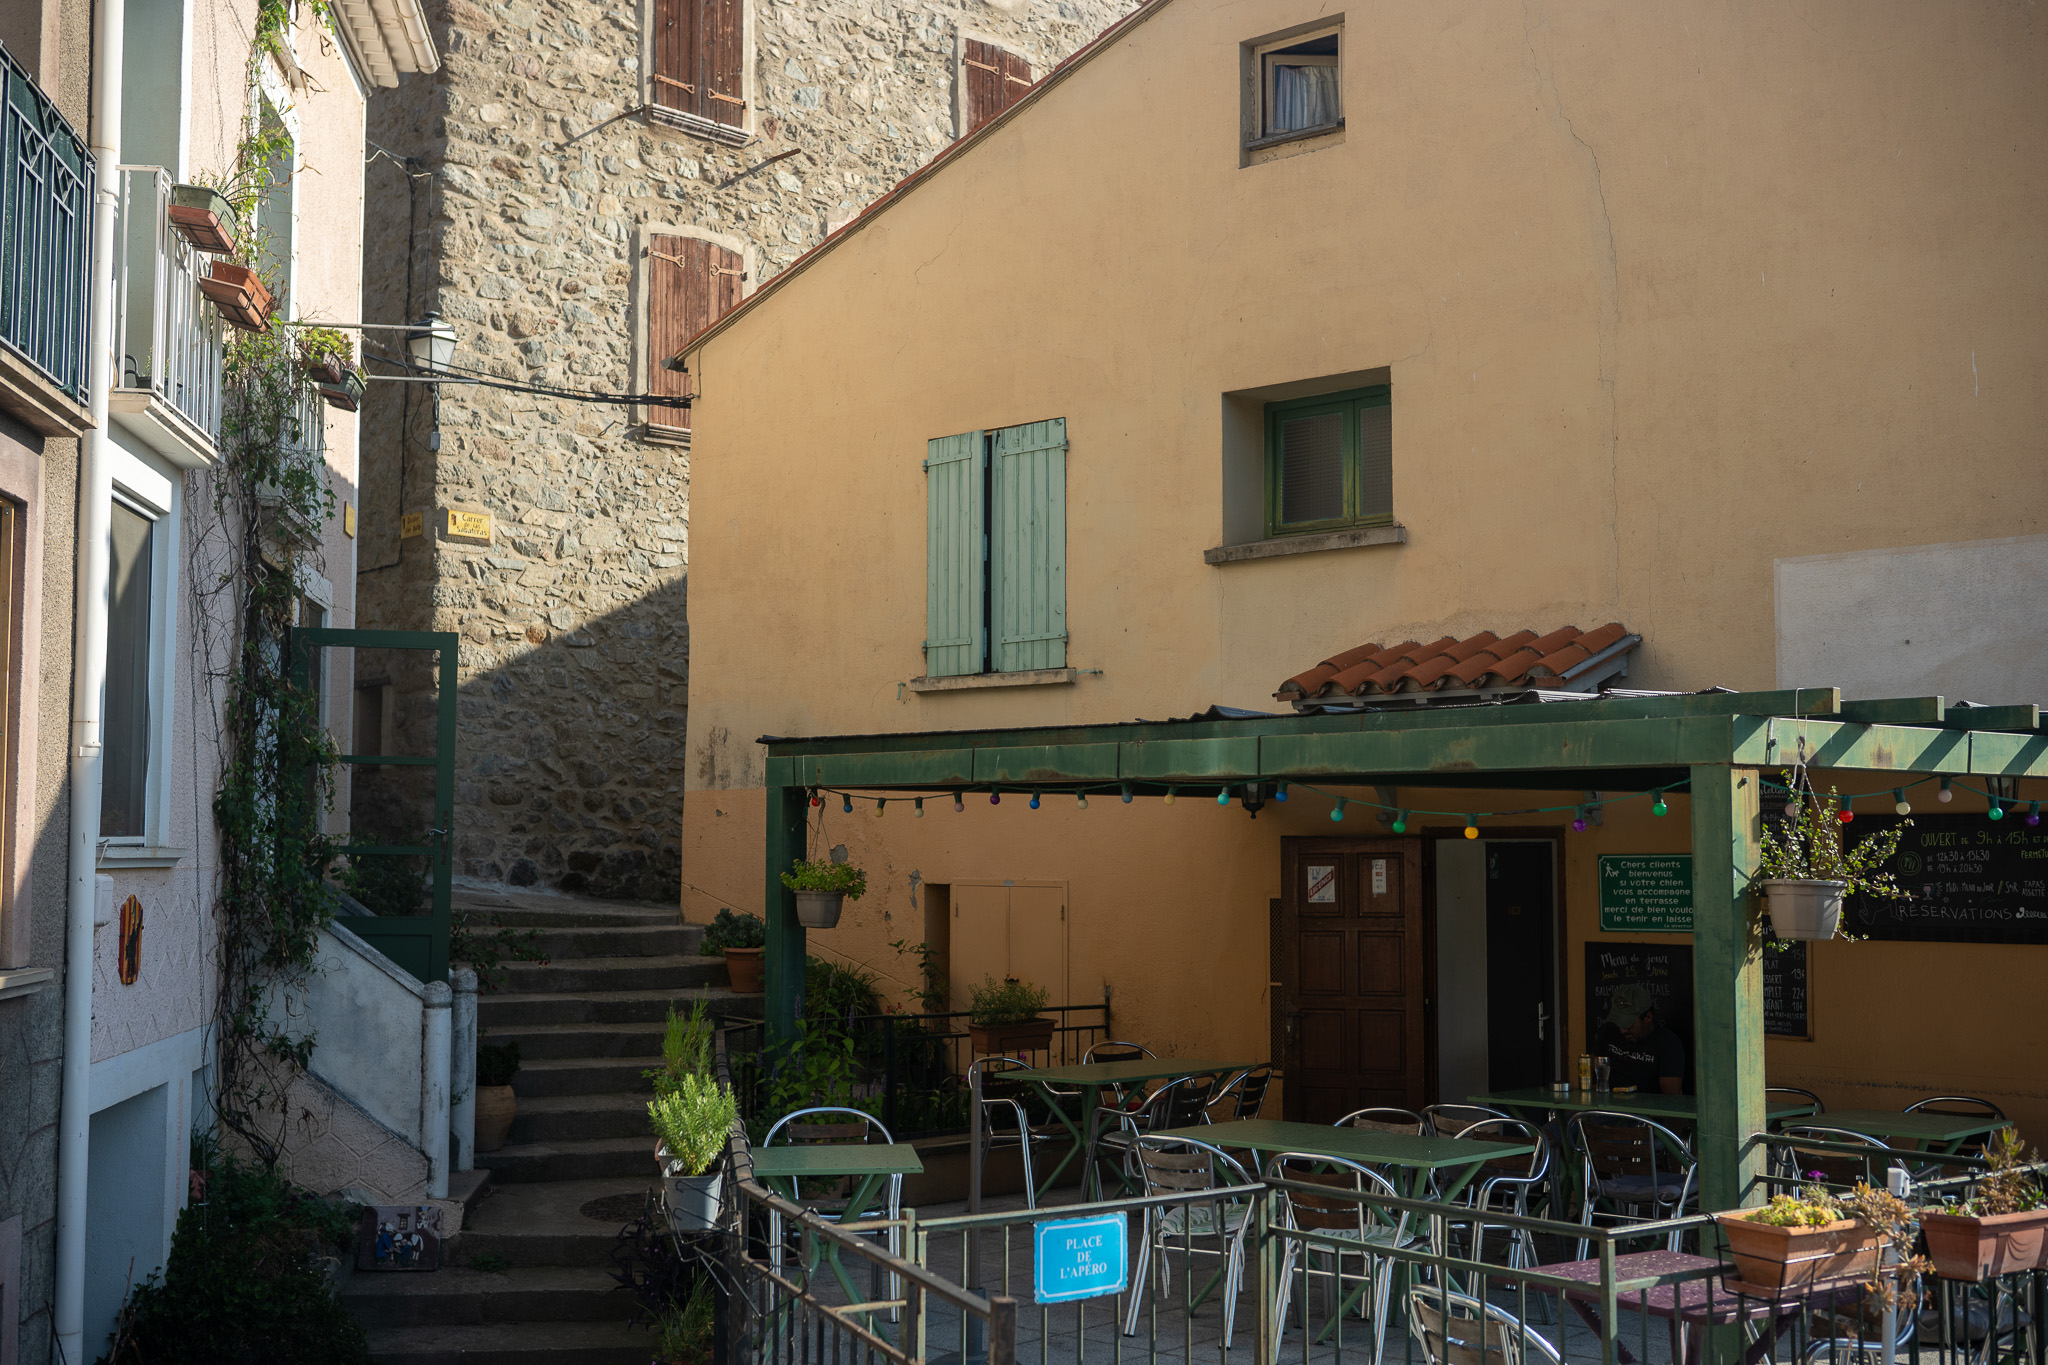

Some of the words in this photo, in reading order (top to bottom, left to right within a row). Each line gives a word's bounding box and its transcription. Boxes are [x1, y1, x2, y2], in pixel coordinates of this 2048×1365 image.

[461, 513, 483, 523] Carrer
[1921, 832, 1957, 847] OUVERT
[1976, 830, 1993, 845] 9h
[2005, 831, 2028, 845] 15h
[1936, 851, 1959, 862] 12h30
[1966, 850, 1990, 861] 13h30
[1620, 861, 1646, 869] Chers
[1649, 861, 1681, 869] clients
[1937, 863, 1951, 874] 19h
[1959, 863, 1983, 874] 20h30
[1659, 879, 1684, 887] chien
[2023, 880, 2046, 889] TAPAS
[1637, 889, 1691, 897] accompagne
[1640, 897, 1679, 905] terrasse
[1647, 906, 1666, 914] bien
[1666, 915, 1692, 923] laisse
[1600, 952, 1628, 968] Menu
[1625, 966, 1638, 979] 25
[1791, 968, 1805, 980] 19€
[1792, 987, 1805, 999] 22€
[1792, 1001, 1803, 1012] 10€
[1066, 1235, 1102, 1251] PLACE
[1077, 1250, 1092, 1263] DE
[1060, 1261, 1107, 1280] L'APÉRO
